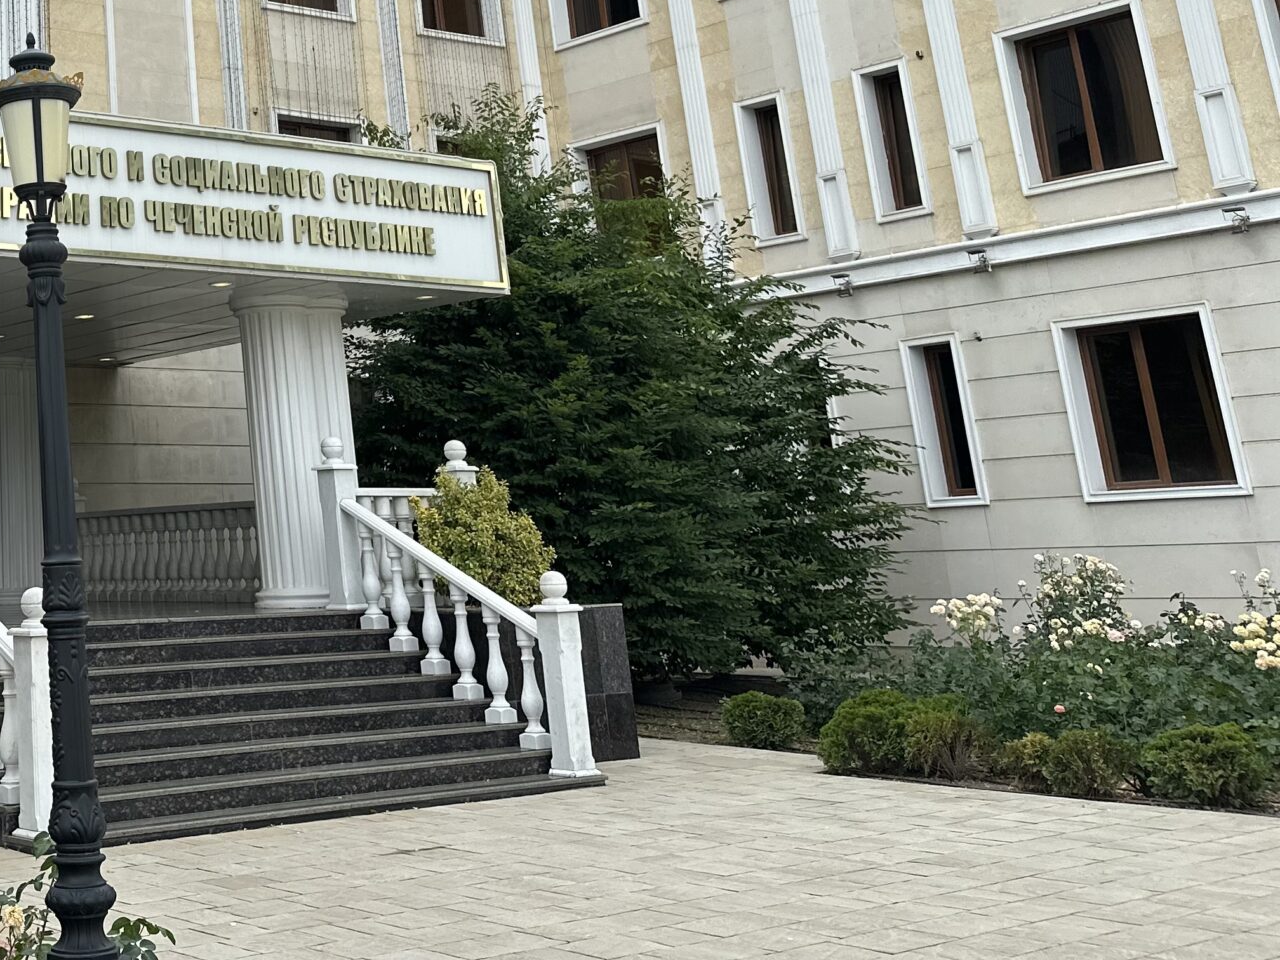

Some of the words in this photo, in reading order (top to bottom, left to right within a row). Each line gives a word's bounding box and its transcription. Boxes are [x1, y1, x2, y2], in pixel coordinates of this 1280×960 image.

[127, 150, 144, 182] И
[153, 153, 325, 200] СОЦИАЛЬНОГО
[334, 173, 488, 217] СТРАХОВАНИЯ
[100, 195, 135, 229] ПО
[144, 199, 283, 243] ЧЕЧЕНСКОЙ
[293, 213, 436, 256] РЕСПУБЛИКЕ
